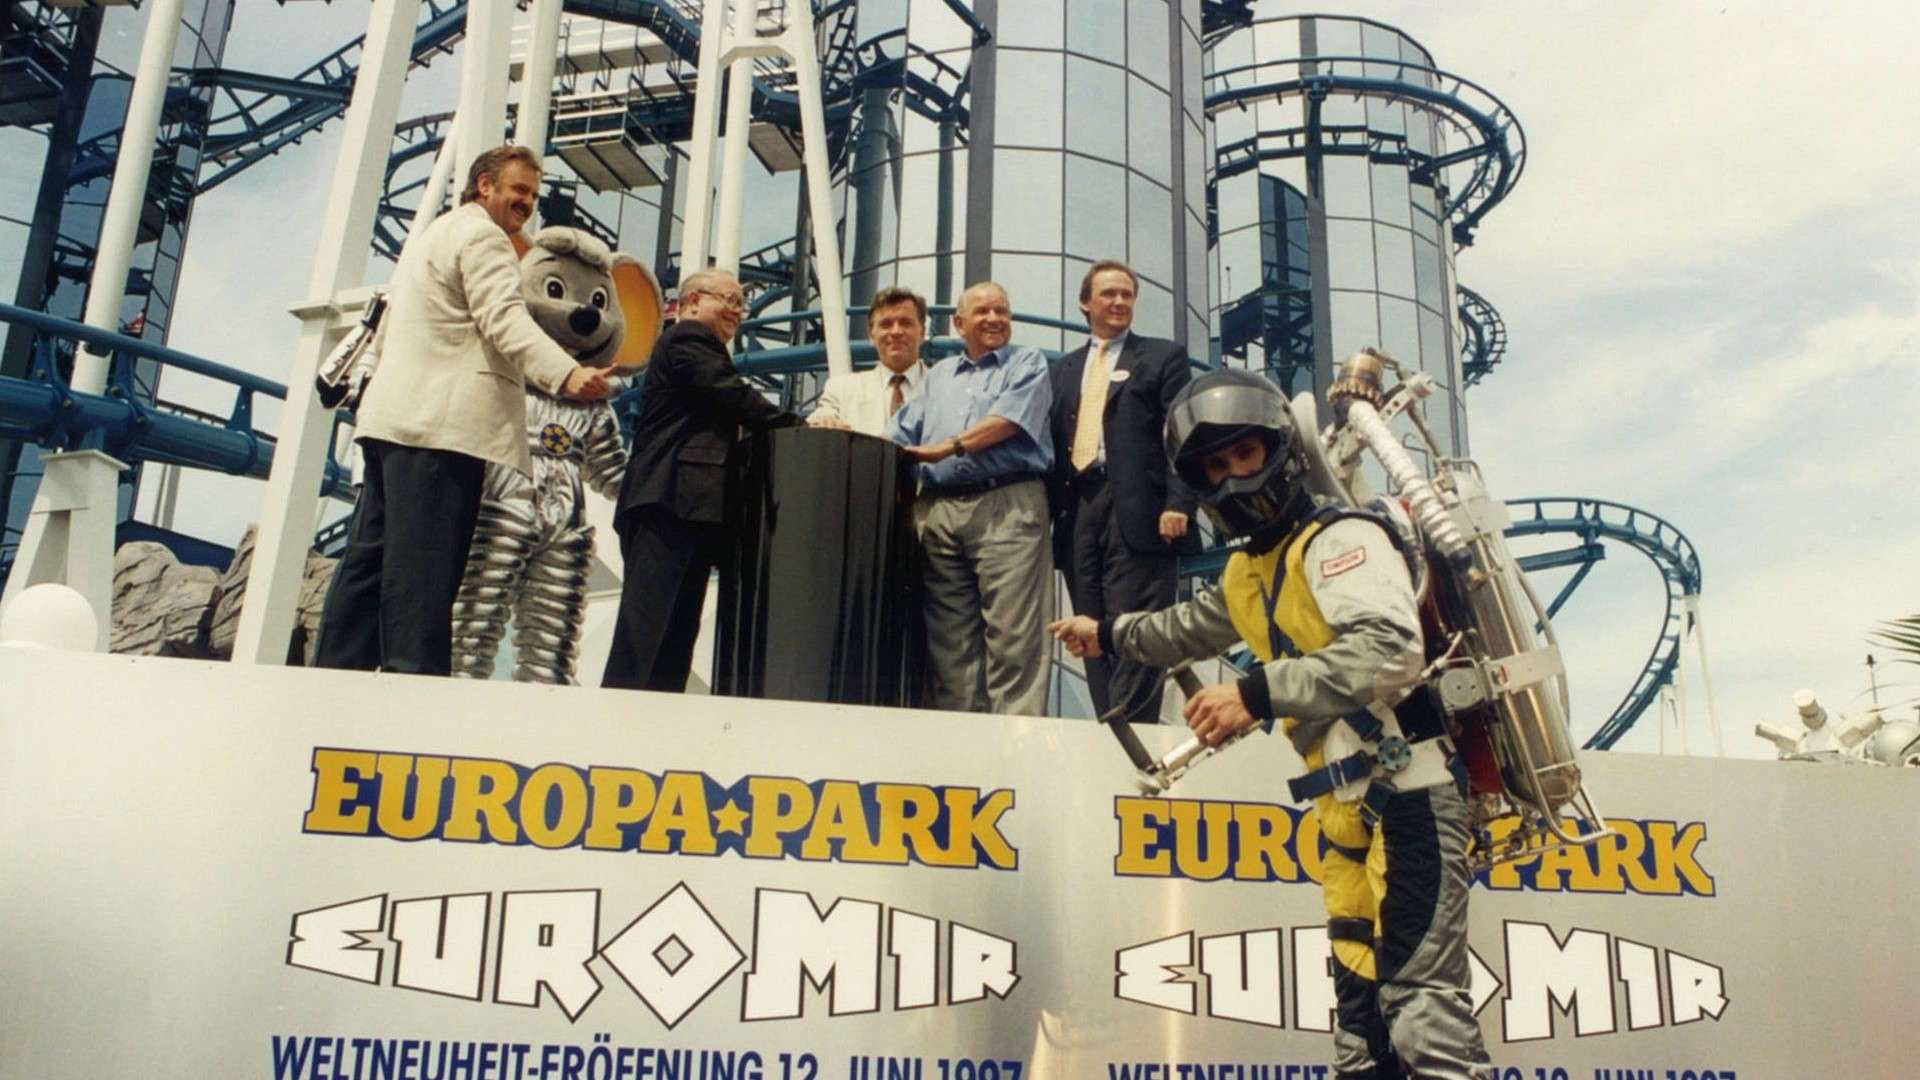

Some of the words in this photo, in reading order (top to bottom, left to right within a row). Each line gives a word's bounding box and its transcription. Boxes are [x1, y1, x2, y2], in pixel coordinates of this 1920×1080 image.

[302, 746, 719, 857] EUROPA
[746, 774, 1019, 871] PARK
[1482, 812, 1717, 898] PARK
[285, 880, 1021, 1030] EUROMIR
[1112, 918, 1731, 1044] EURMIR
